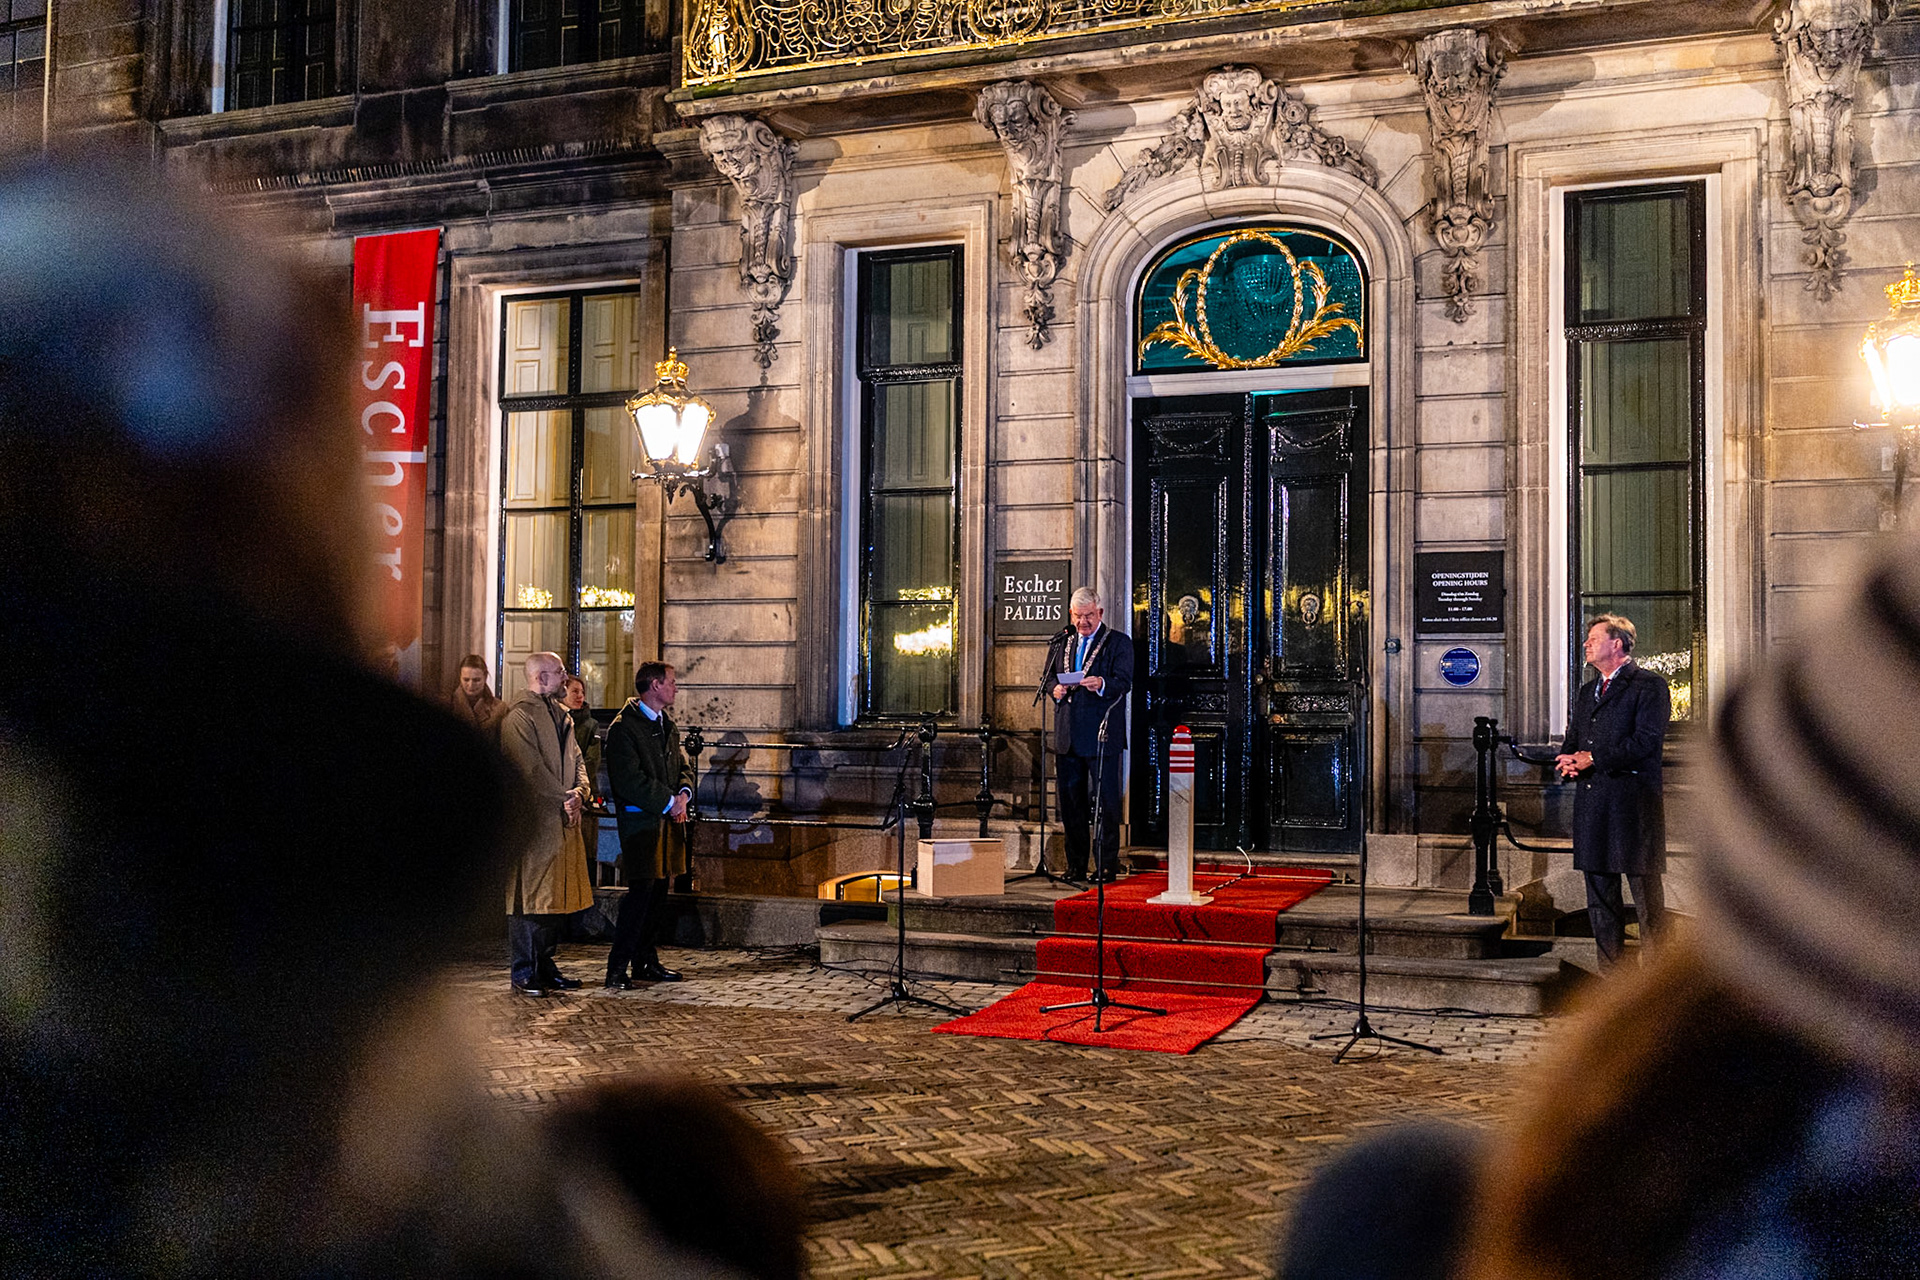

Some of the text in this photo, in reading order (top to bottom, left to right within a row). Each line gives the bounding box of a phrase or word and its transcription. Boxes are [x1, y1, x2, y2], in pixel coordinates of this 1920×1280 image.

[361, 302, 427, 581] Escher
[1003, 573, 1063, 593] Escher
[1018, 595, 1047, 603] IN HET
[1003, 604, 1062, 621] PALEIS
